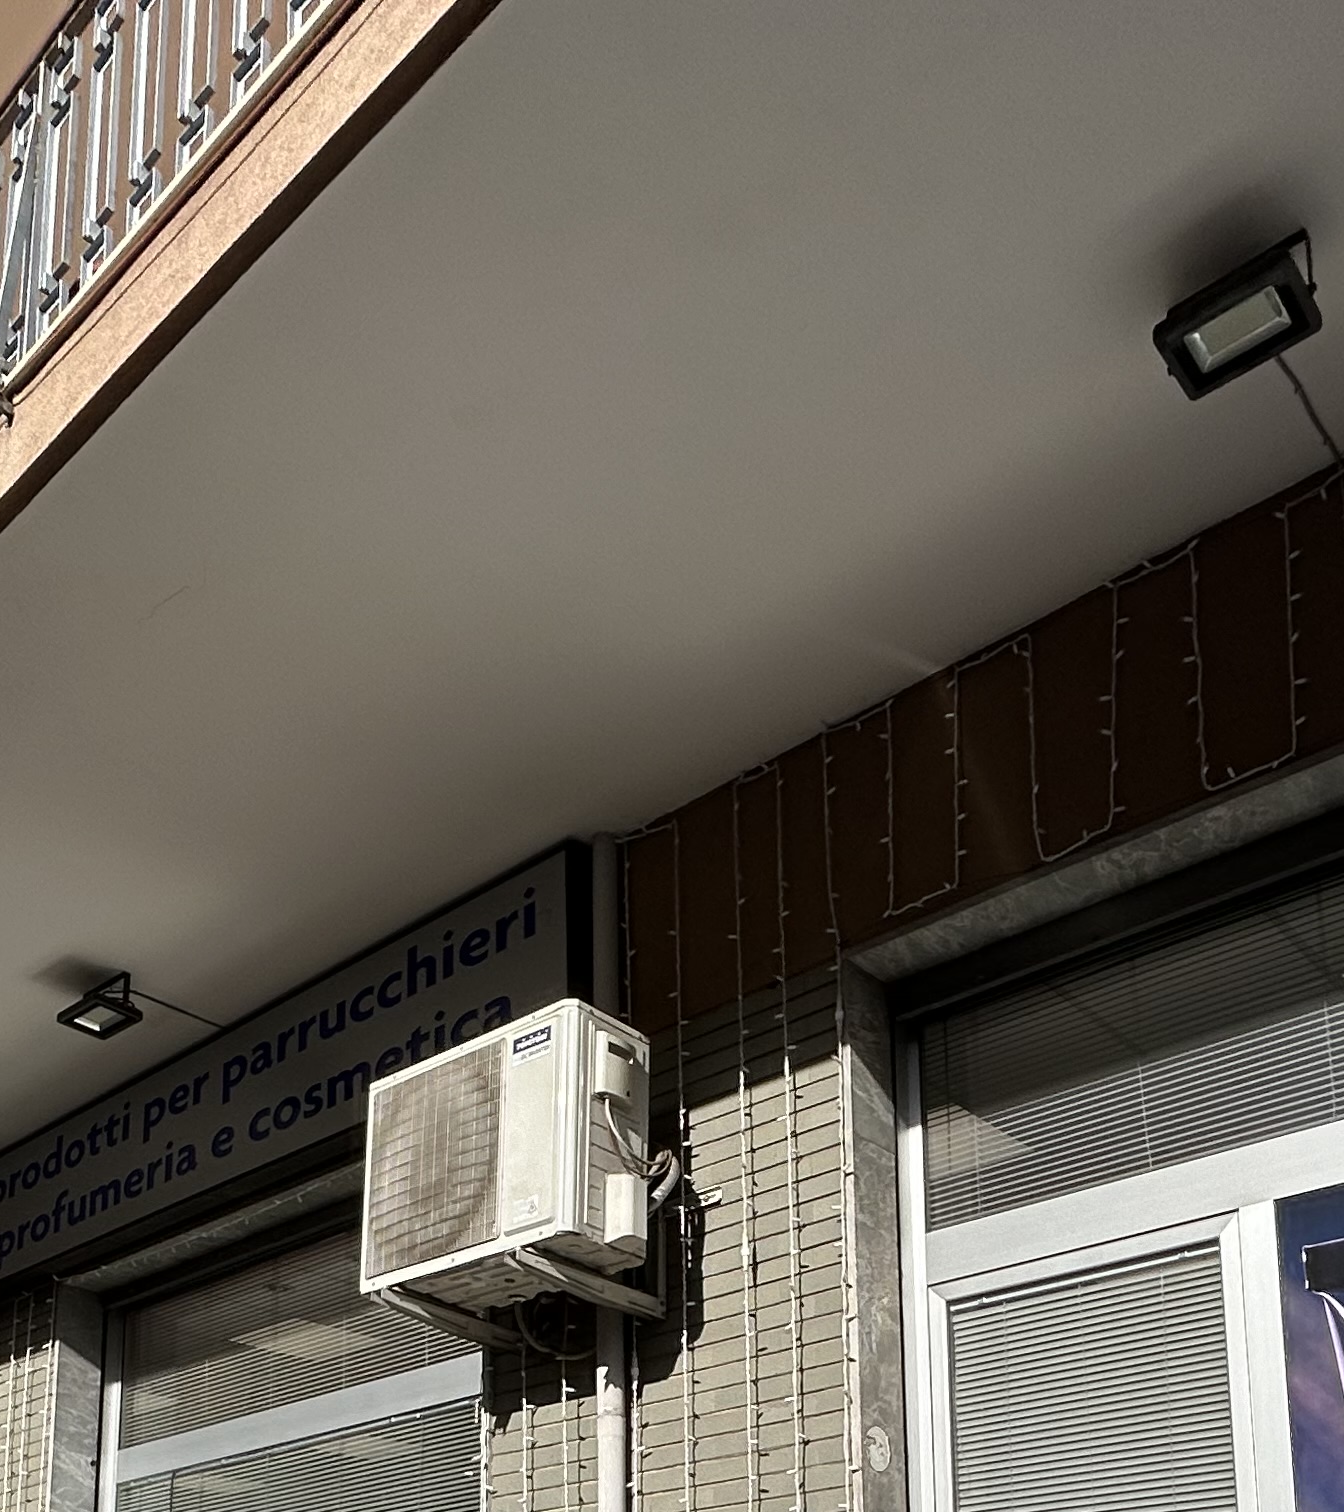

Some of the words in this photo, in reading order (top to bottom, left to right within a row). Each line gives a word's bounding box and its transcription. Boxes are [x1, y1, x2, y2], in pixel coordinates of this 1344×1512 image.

[142, 1071, 209, 1144] per
[222, 886, 536, 1104] parrucchieri
[211, 1125, 234, 1158] e
[248, 995, 513, 1142] cosmetica
